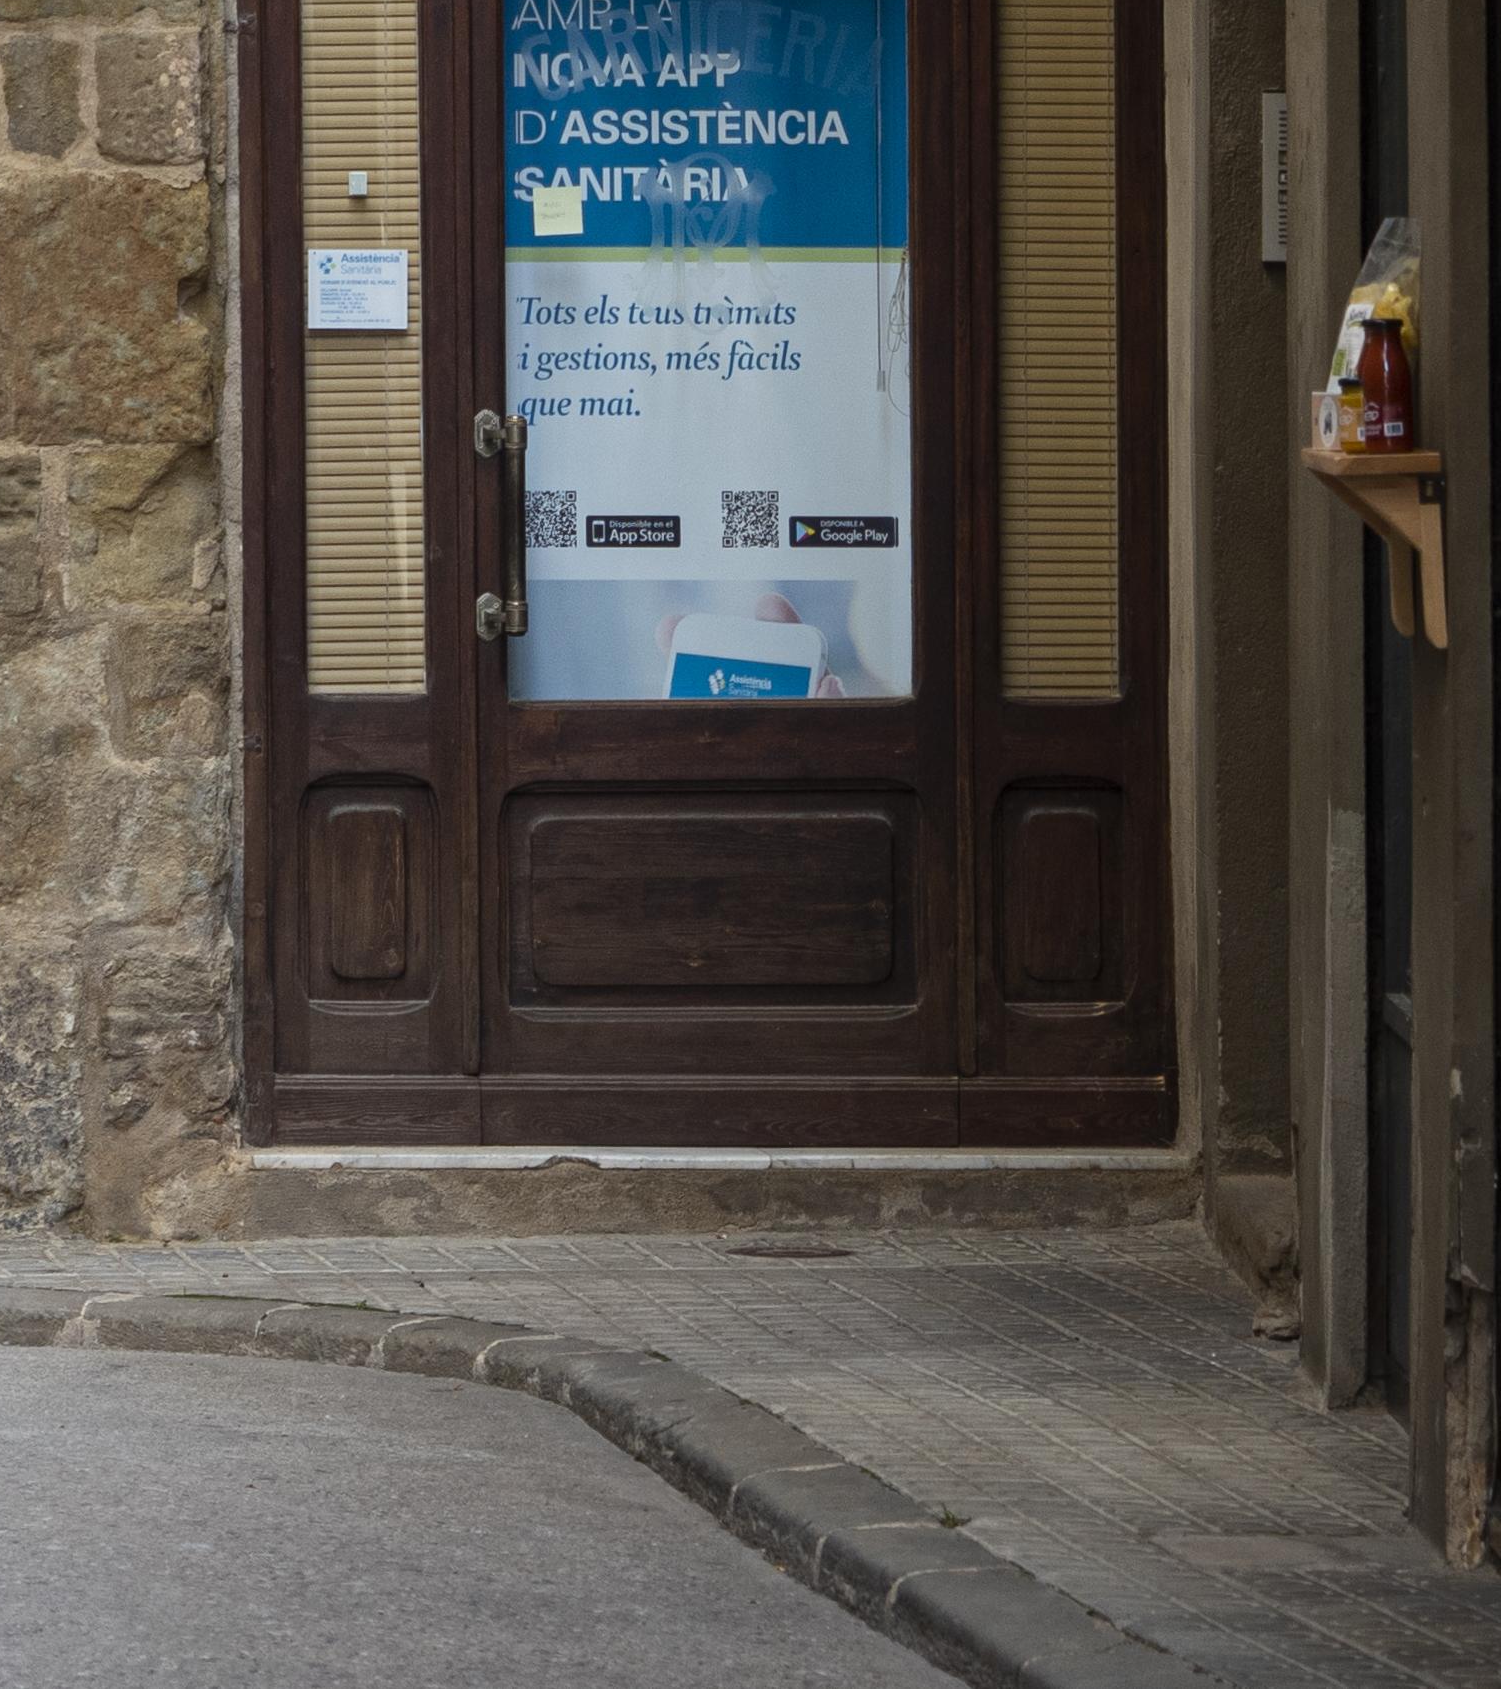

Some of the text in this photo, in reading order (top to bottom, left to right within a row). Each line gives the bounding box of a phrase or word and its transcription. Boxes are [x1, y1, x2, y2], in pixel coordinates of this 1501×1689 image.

[514, 52, 741, 88] NOVA APP
[515, 102, 850, 146] D'ASSISTÈNCIA
[519, 296, 577, 326] Tots
[583, 294, 621, 326] els
[520, 339, 802, 381] i gestions, més fàcils
[520, 388, 642, 426] que mai.
[609, 520, 653, 530] Disponible
[666, 520, 674, 529] el
[609, 528, 675, 544] App Store
[820, 528, 889, 544] Google Play
